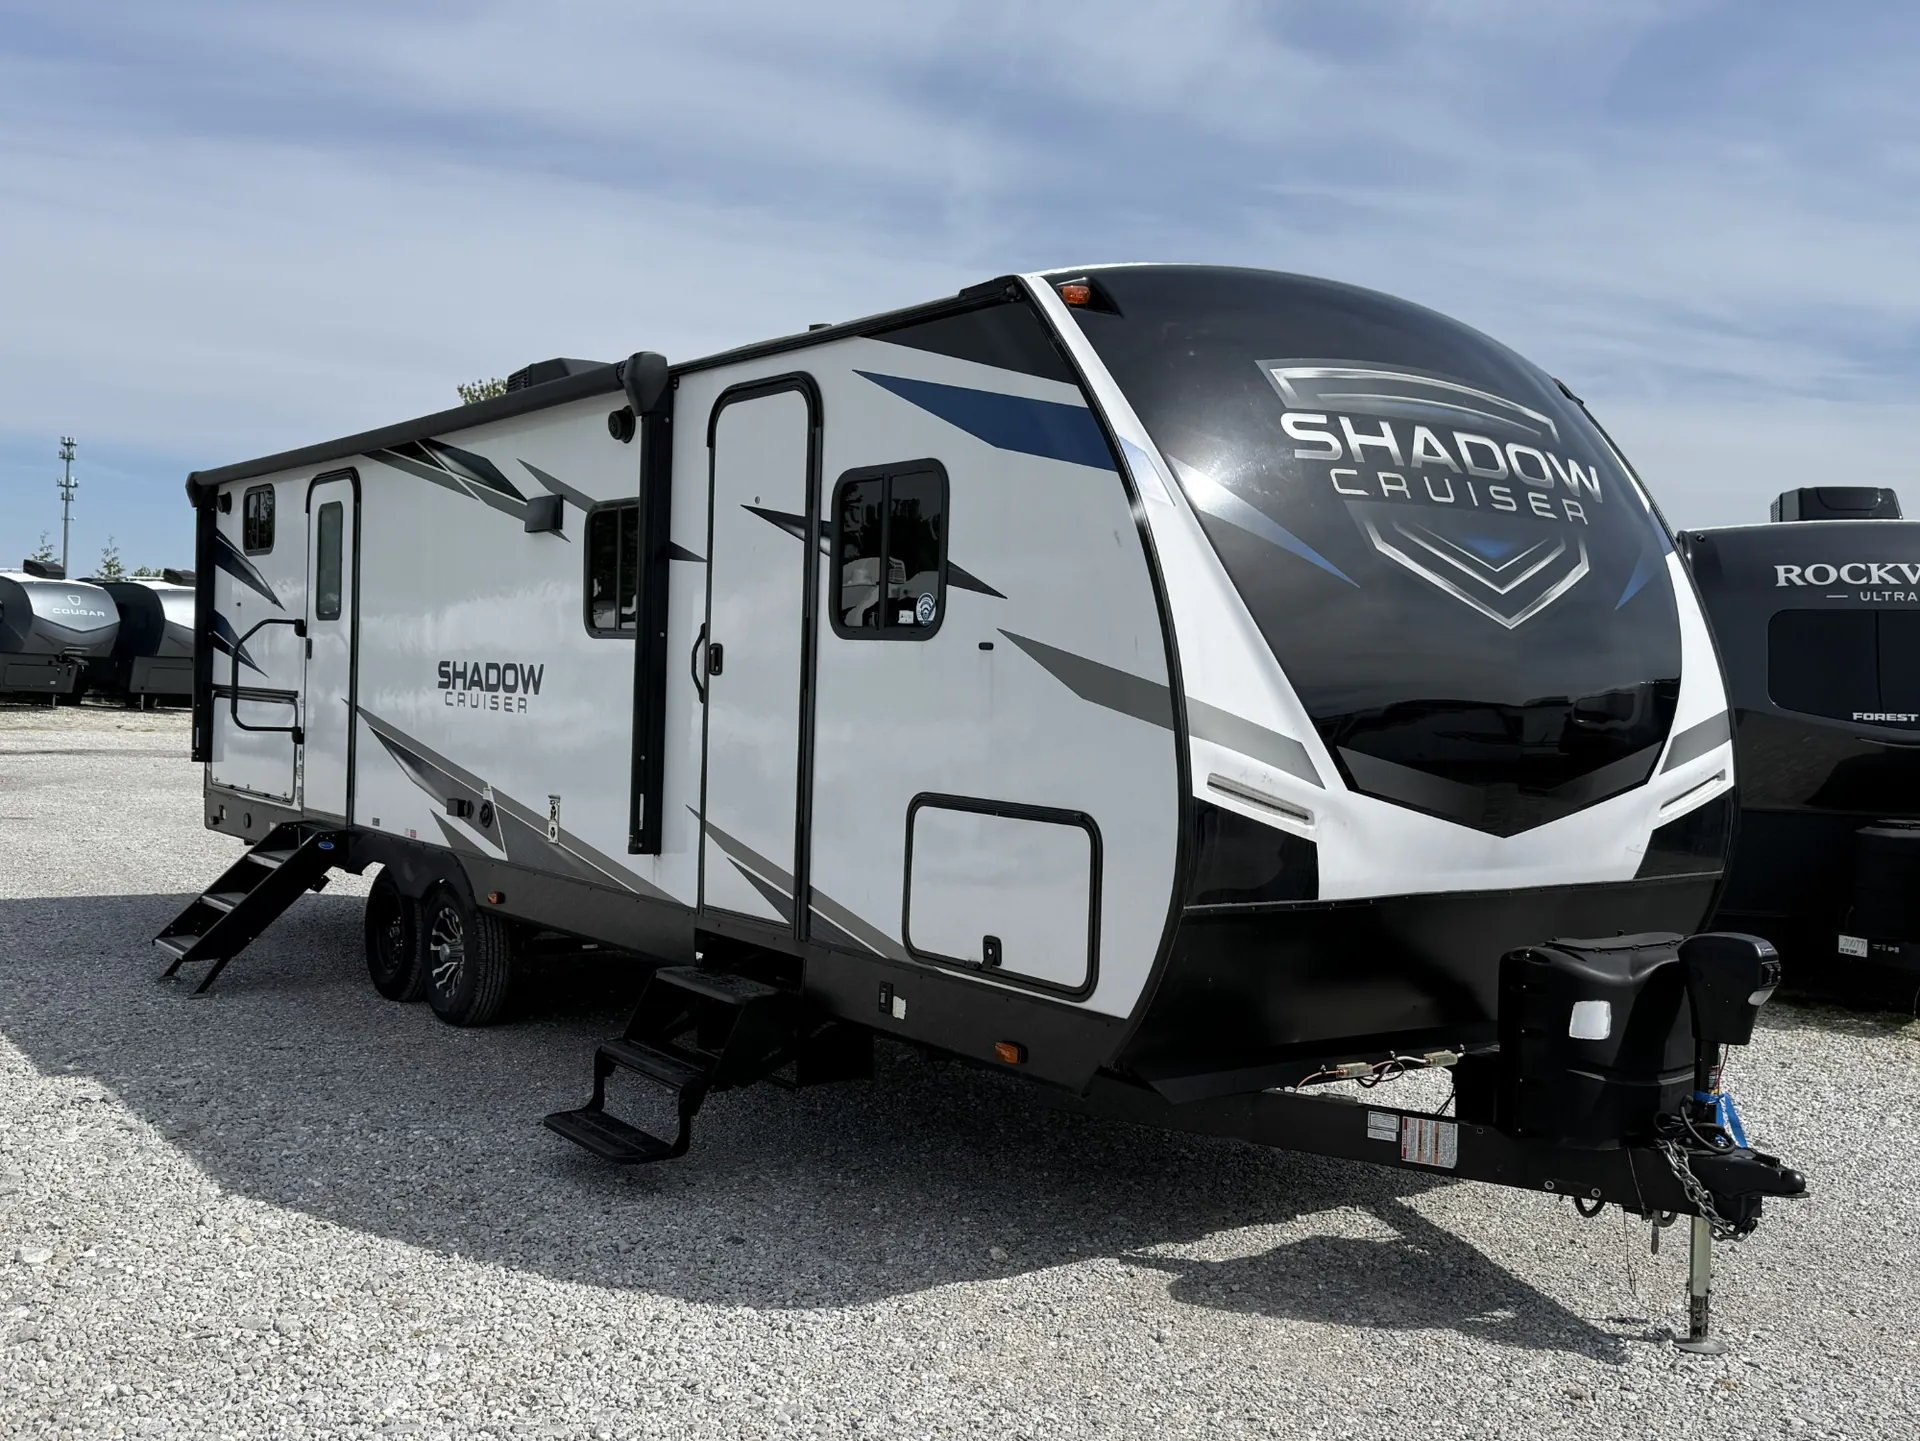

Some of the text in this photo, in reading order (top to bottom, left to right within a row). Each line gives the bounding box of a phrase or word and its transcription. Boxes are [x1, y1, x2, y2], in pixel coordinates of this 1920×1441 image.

[1280, 412, 1603, 503] SHADOW
[1329, 468, 1589, 525] CRUISER
[1860, 591, 1918, 601] ULTRA
[53, 608, 105, 617] COUGAR
[438, 661, 544, 695] SHADOW
[445, 692, 527, 713] CRUISER
[1852, 712, 1919, 721] FOREST
